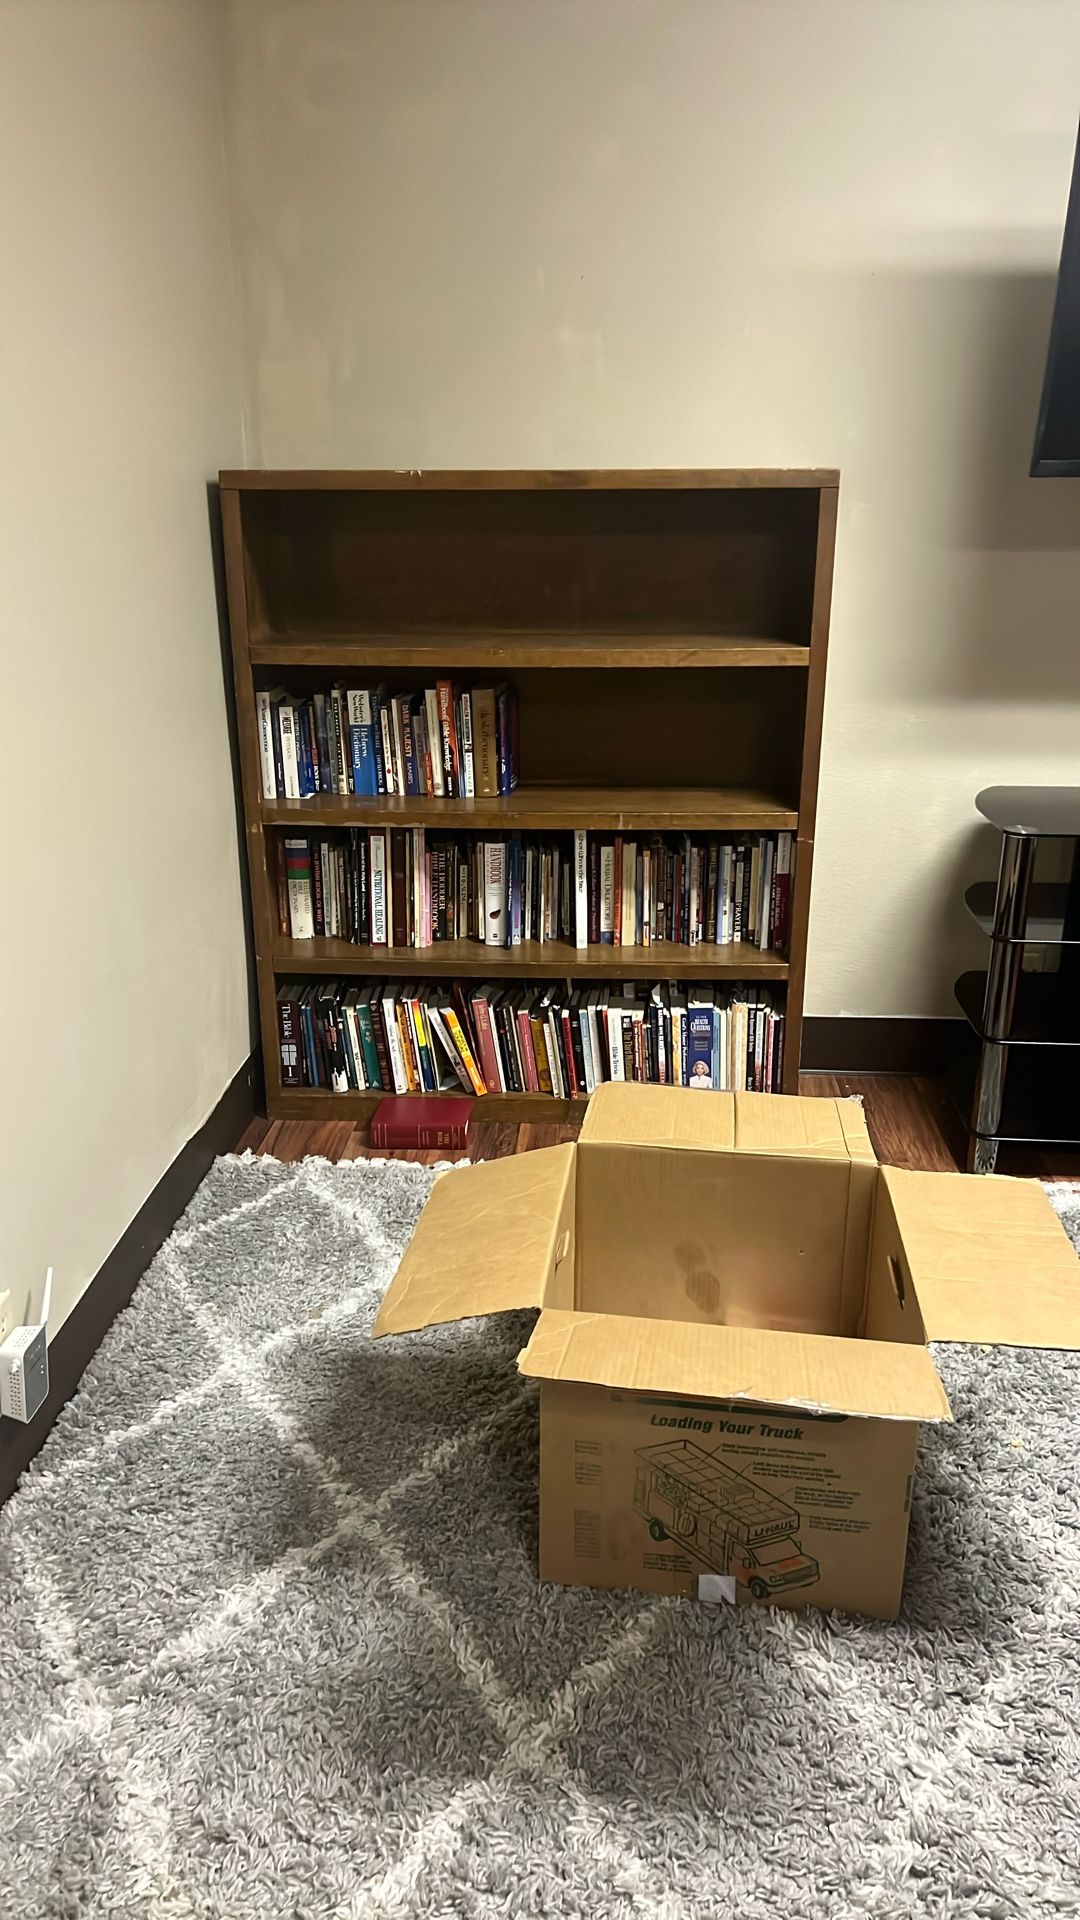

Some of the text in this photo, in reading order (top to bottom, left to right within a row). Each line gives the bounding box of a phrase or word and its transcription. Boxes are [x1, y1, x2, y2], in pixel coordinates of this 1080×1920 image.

[353, 728, 361, 769] Dictionary
[361, 728, 369, 757] Hebrew
[404, 727, 412, 757] MAJESTY
[444, 738, 452, 771] Knowledge
[490, 847, 502, 884] HANDBOOK
[374, 870, 383, 908] NUTRITIONAL
[604, 884, 612, 920] DRUGSTORE
[375, 909, 383, 934] HEALING
[623, 1031, 632, 1040] The
[624, 1041, 633, 1054] Third
[650, 1414, 805, 1440] Loading Your Truck
